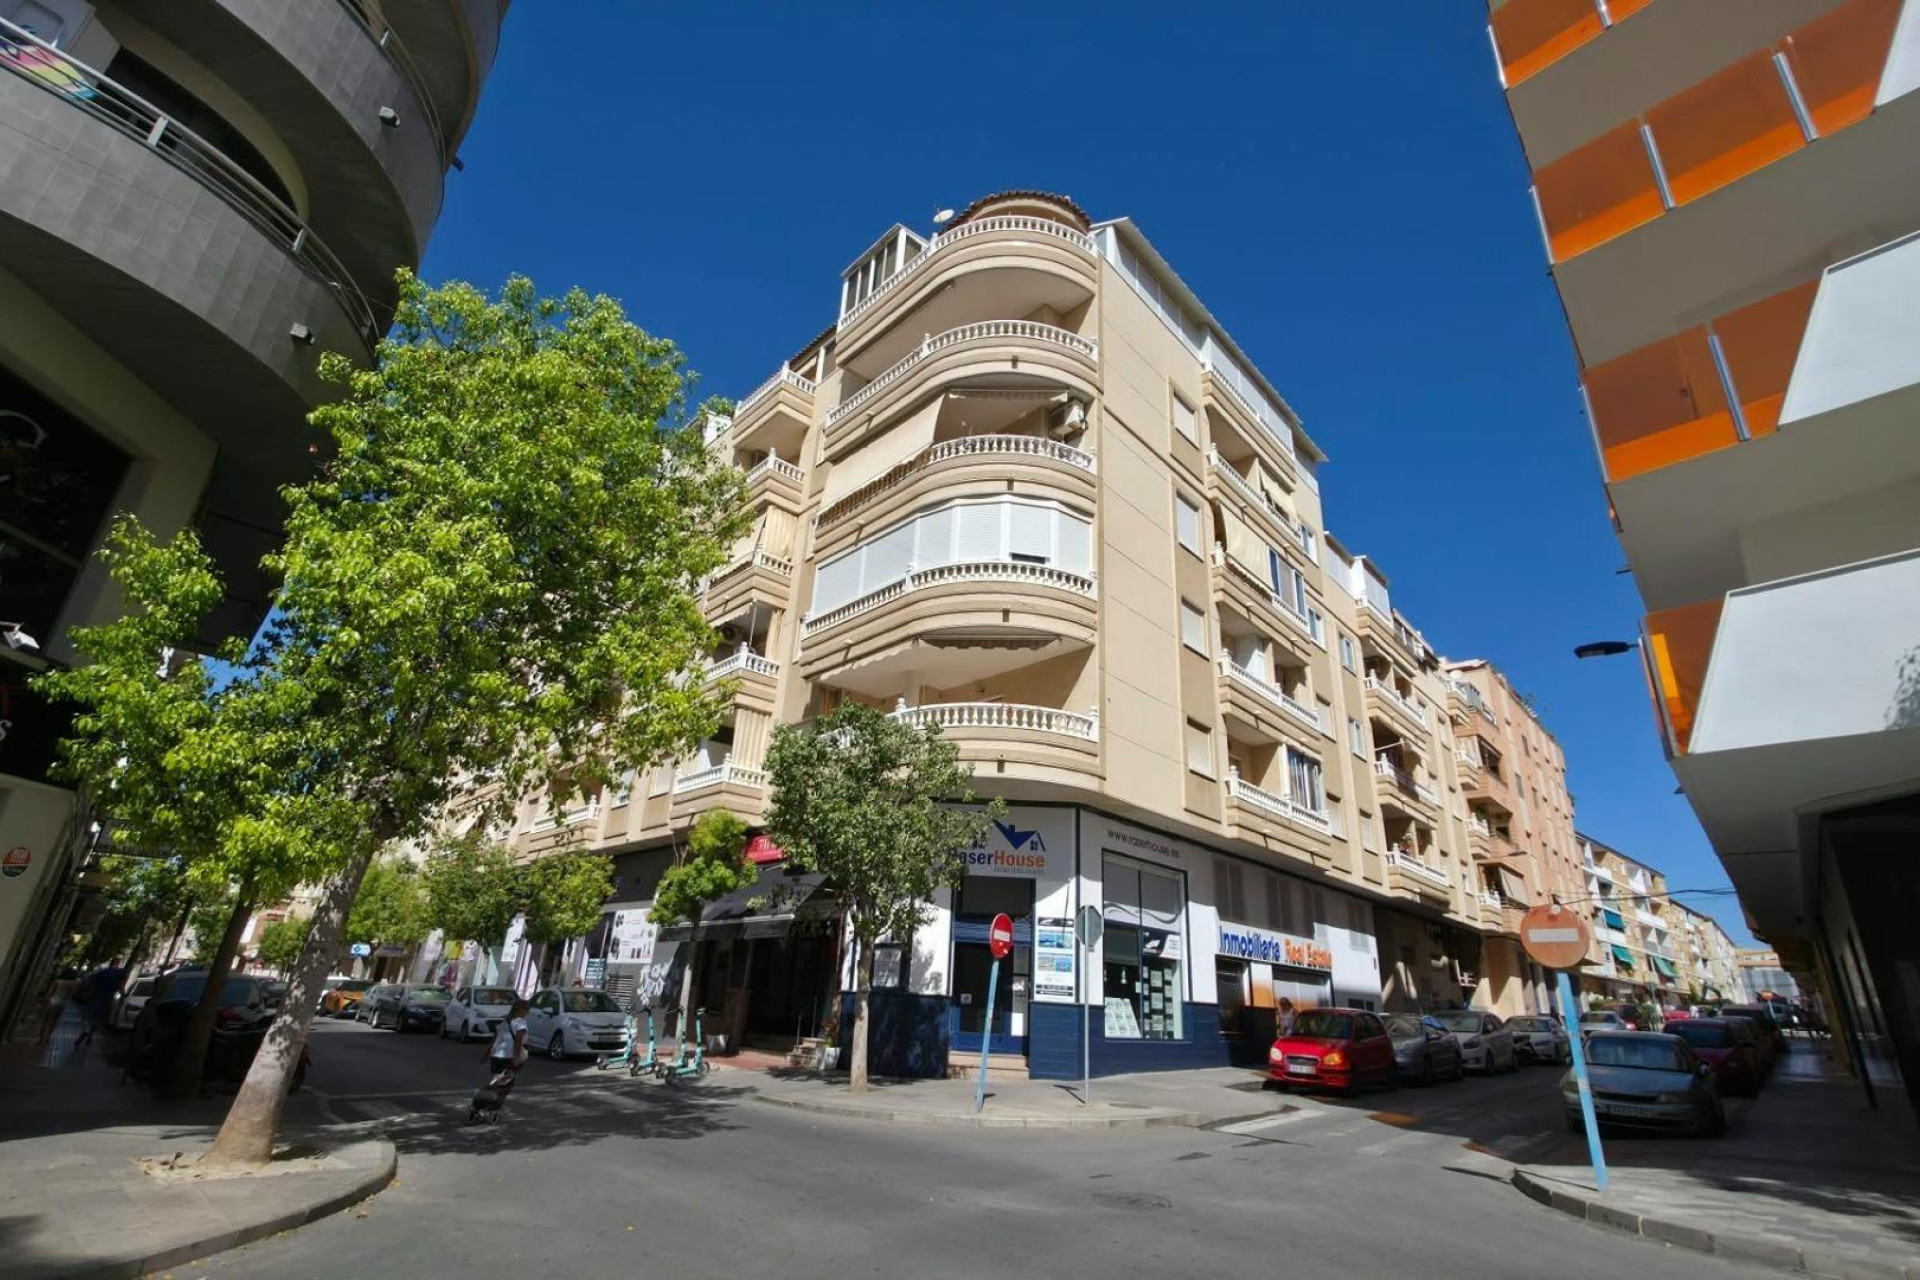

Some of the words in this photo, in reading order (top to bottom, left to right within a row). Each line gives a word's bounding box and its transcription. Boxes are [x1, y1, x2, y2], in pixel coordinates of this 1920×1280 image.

[957, 850, 1046, 868] aserHouse
[1219, 925, 1281, 961] Inmobiliaria
[1284, 938, 1305, 966] Real
